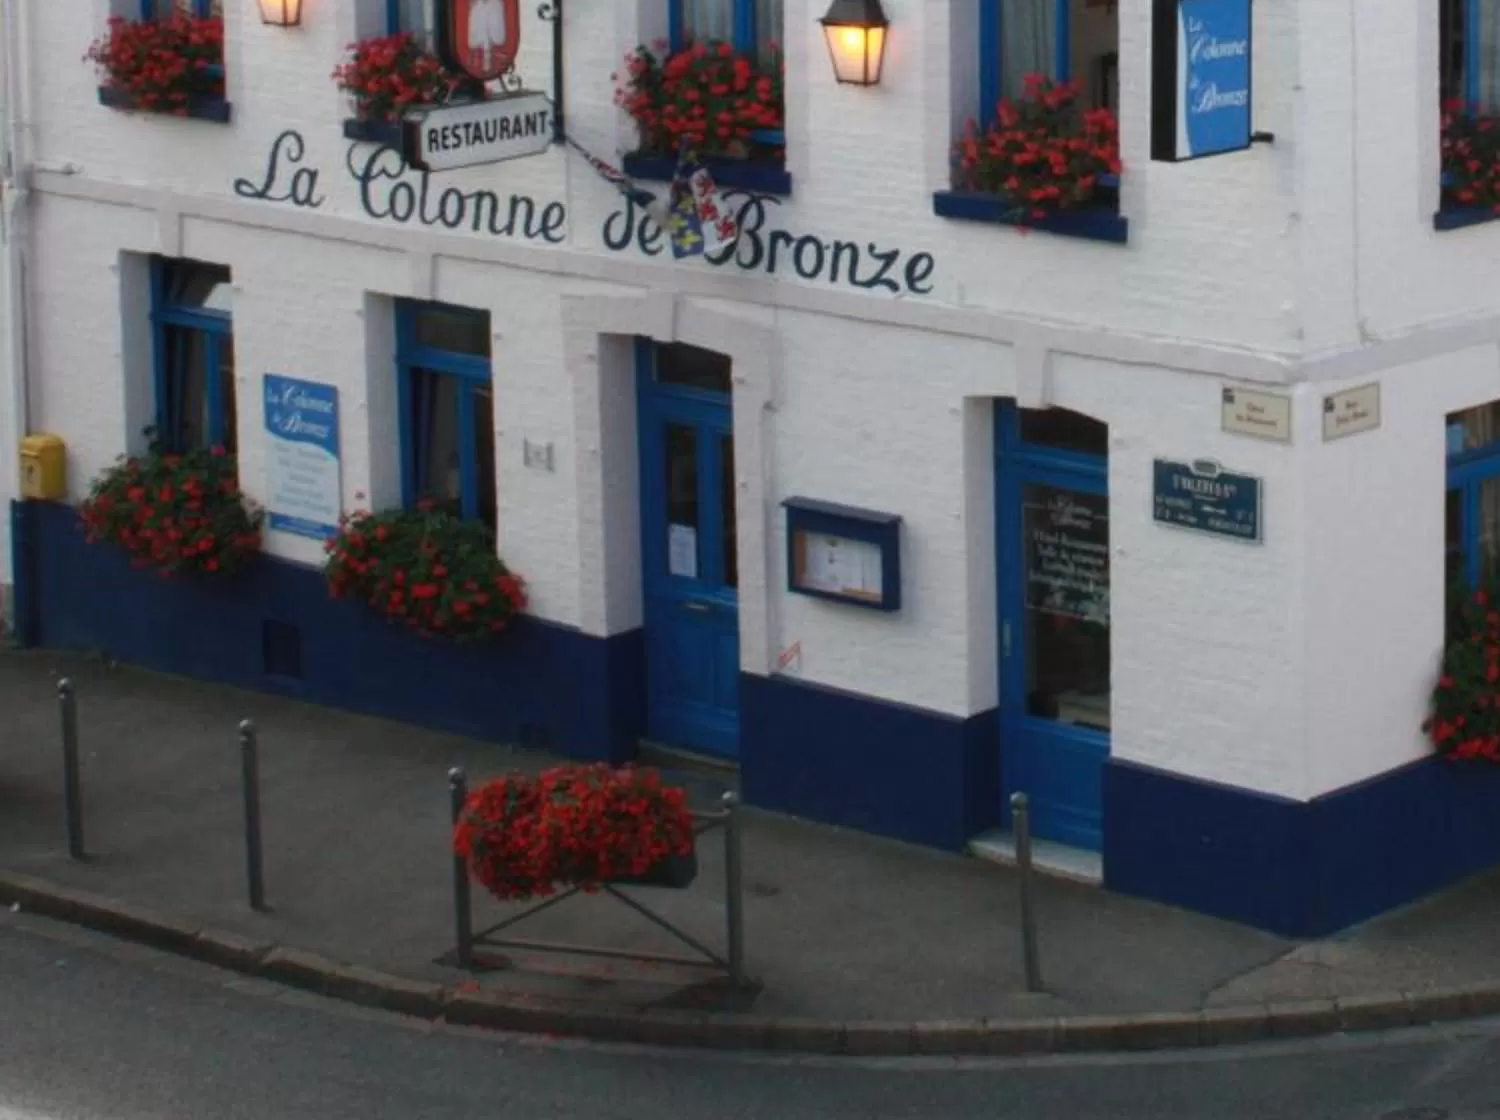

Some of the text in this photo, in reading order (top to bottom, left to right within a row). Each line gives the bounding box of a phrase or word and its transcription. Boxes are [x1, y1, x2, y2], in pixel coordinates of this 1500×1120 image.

[427, 111, 548, 153] RESTAURANT
[234, 129, 935, 295] La Colonne de Bronze
